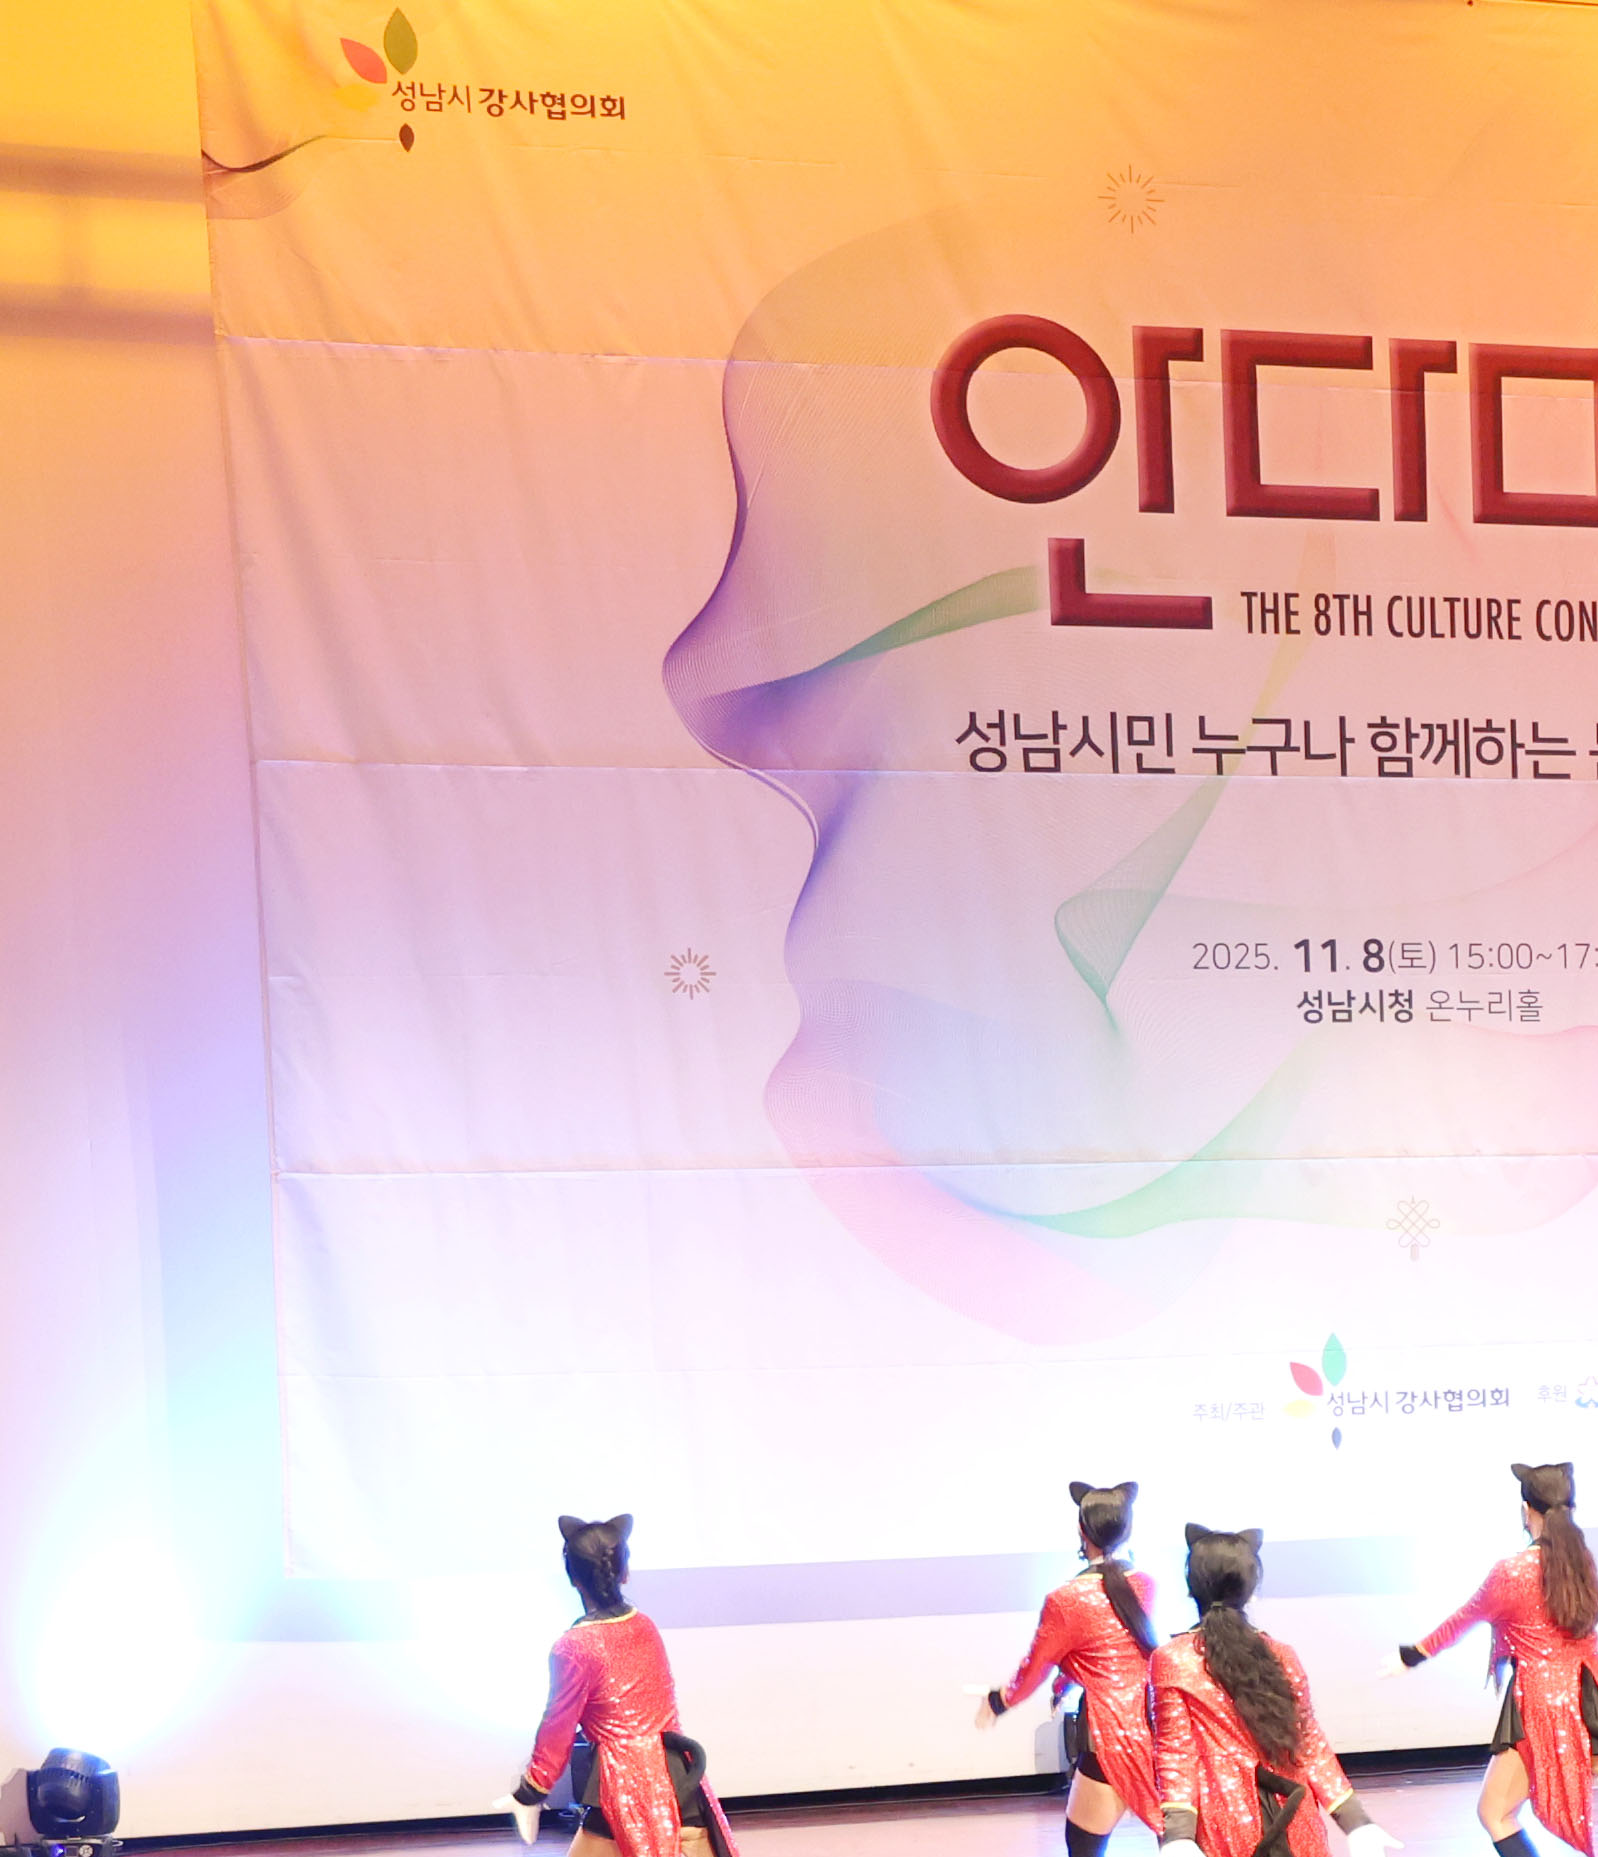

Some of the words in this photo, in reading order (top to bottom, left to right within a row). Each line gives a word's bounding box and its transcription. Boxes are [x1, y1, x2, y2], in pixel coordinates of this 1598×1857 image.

[392, 81, 472, 113] 성남시
[478, 88, 626, 120] 강사협의회
[1240, 591, 1300, 635] THE
[1314, 593, 1373, 636] 8TH
[1387, 595, 1522, 640] CULTURE
[955, 709, 1175, 774] 성남시민
[1192, 714, 1355, 777] 누구나
[1367, 716, 1577, 779] 함께하는
[1192, 942, 1280, 971] 2025.
[1297, 989, 1415, 1025] 성남시청
[1425, 990, 1544, 1023] 온누리홀
[1326, 1391, 1389, 1417] 성남시
[1395, 1387, 1511, 1415] 강사협의회
